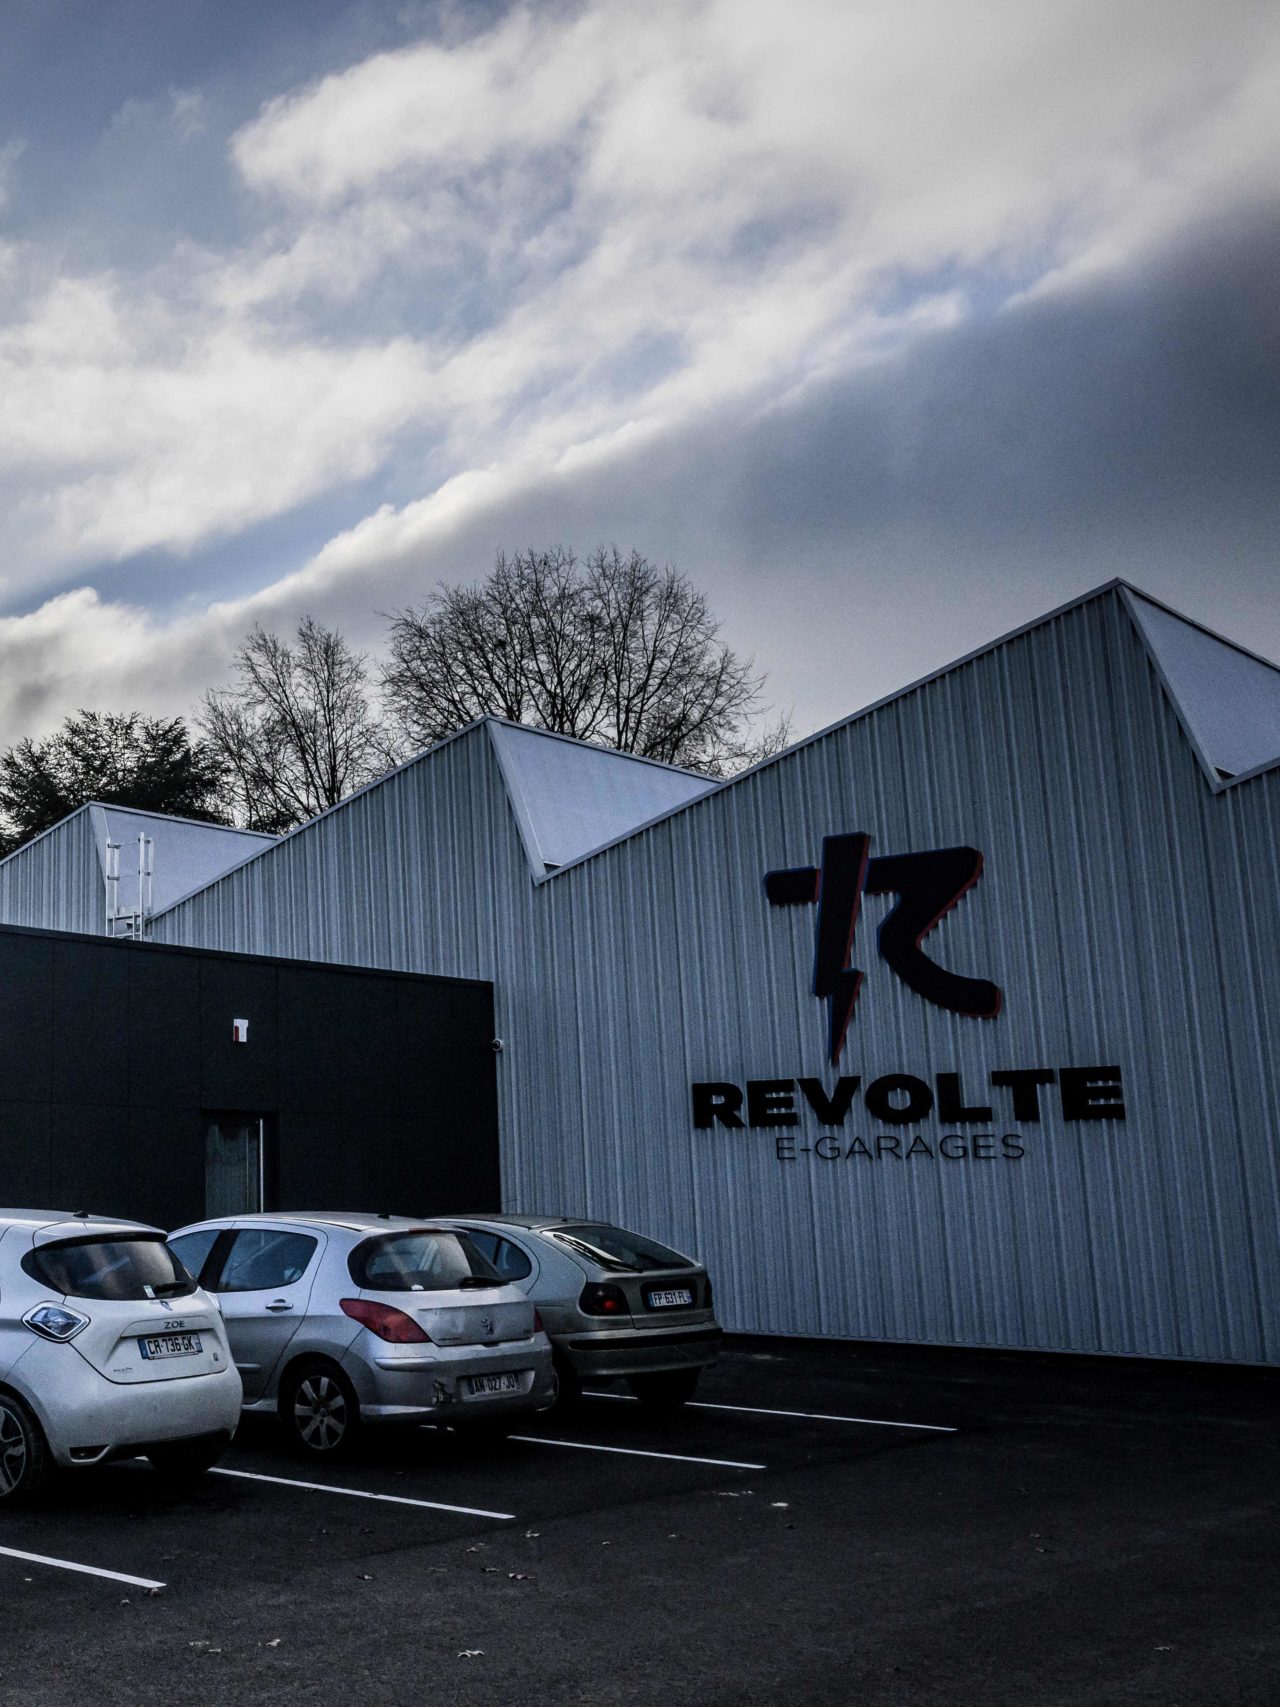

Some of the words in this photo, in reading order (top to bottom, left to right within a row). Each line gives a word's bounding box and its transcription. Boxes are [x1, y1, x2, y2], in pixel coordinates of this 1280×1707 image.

[692, 1065, 1127, 1129] REVOLTE
[776, 1133, 1026, 1161] E-GARAGES
[164, 1320, 186, 1330] ZOE
[146, 1335, 195, 1355] CR-736-GK
